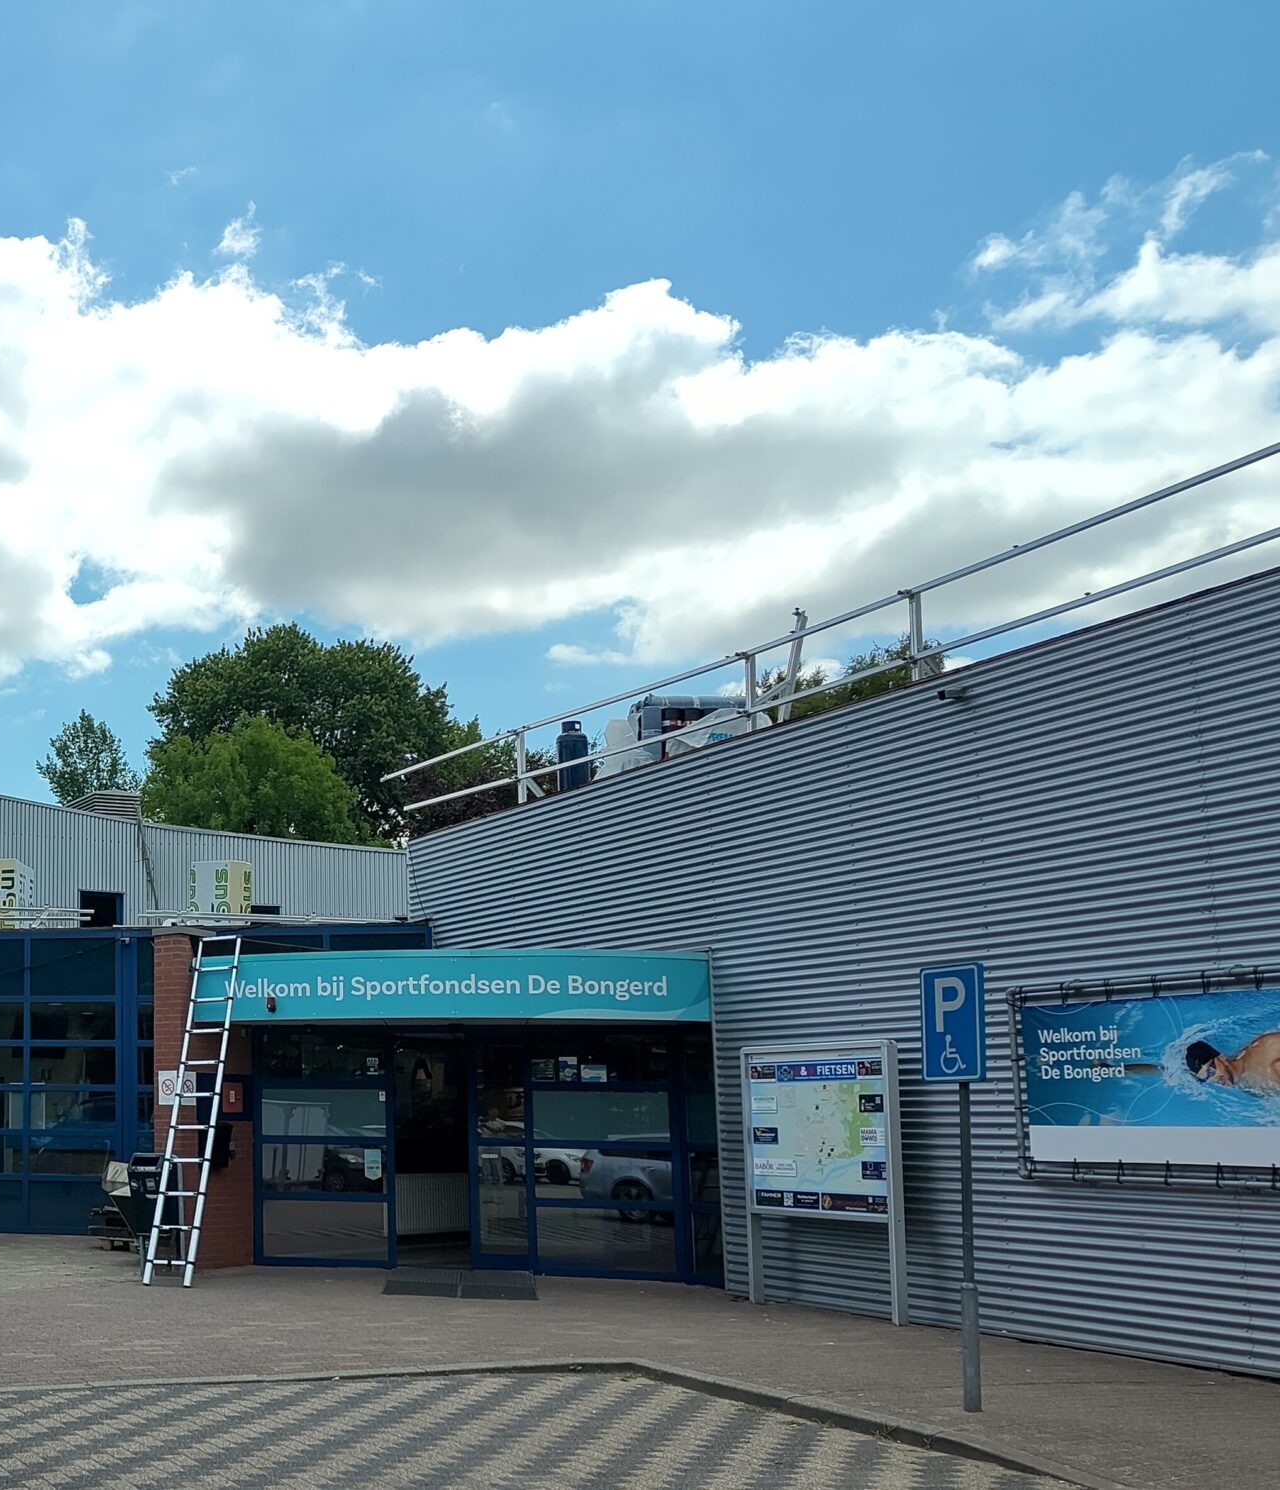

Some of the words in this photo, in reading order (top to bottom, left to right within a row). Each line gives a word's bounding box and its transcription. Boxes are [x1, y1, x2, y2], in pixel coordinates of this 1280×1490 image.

[224, 977, 311, 999] Welkom
[317, 976, 344, 1001] bij
[350, 974, 520, 1001] Sportfondsen
[528, 975, 561, 995] De
[568, 975, 668, 1001] Bongerd
[933, 976, 966, 1033] P
[1037, 1027, 1096, 1044] Welkom
[1099, 1024, 1118, 1044] bij
[1040, 1043, 1141, 1065] Sportfondsen
[816, 1064, 855, 1075] FIETSEN
[1041, 1065, 1061, 1080] De
[1063, 1062, 1125, 1083] Bongerd
